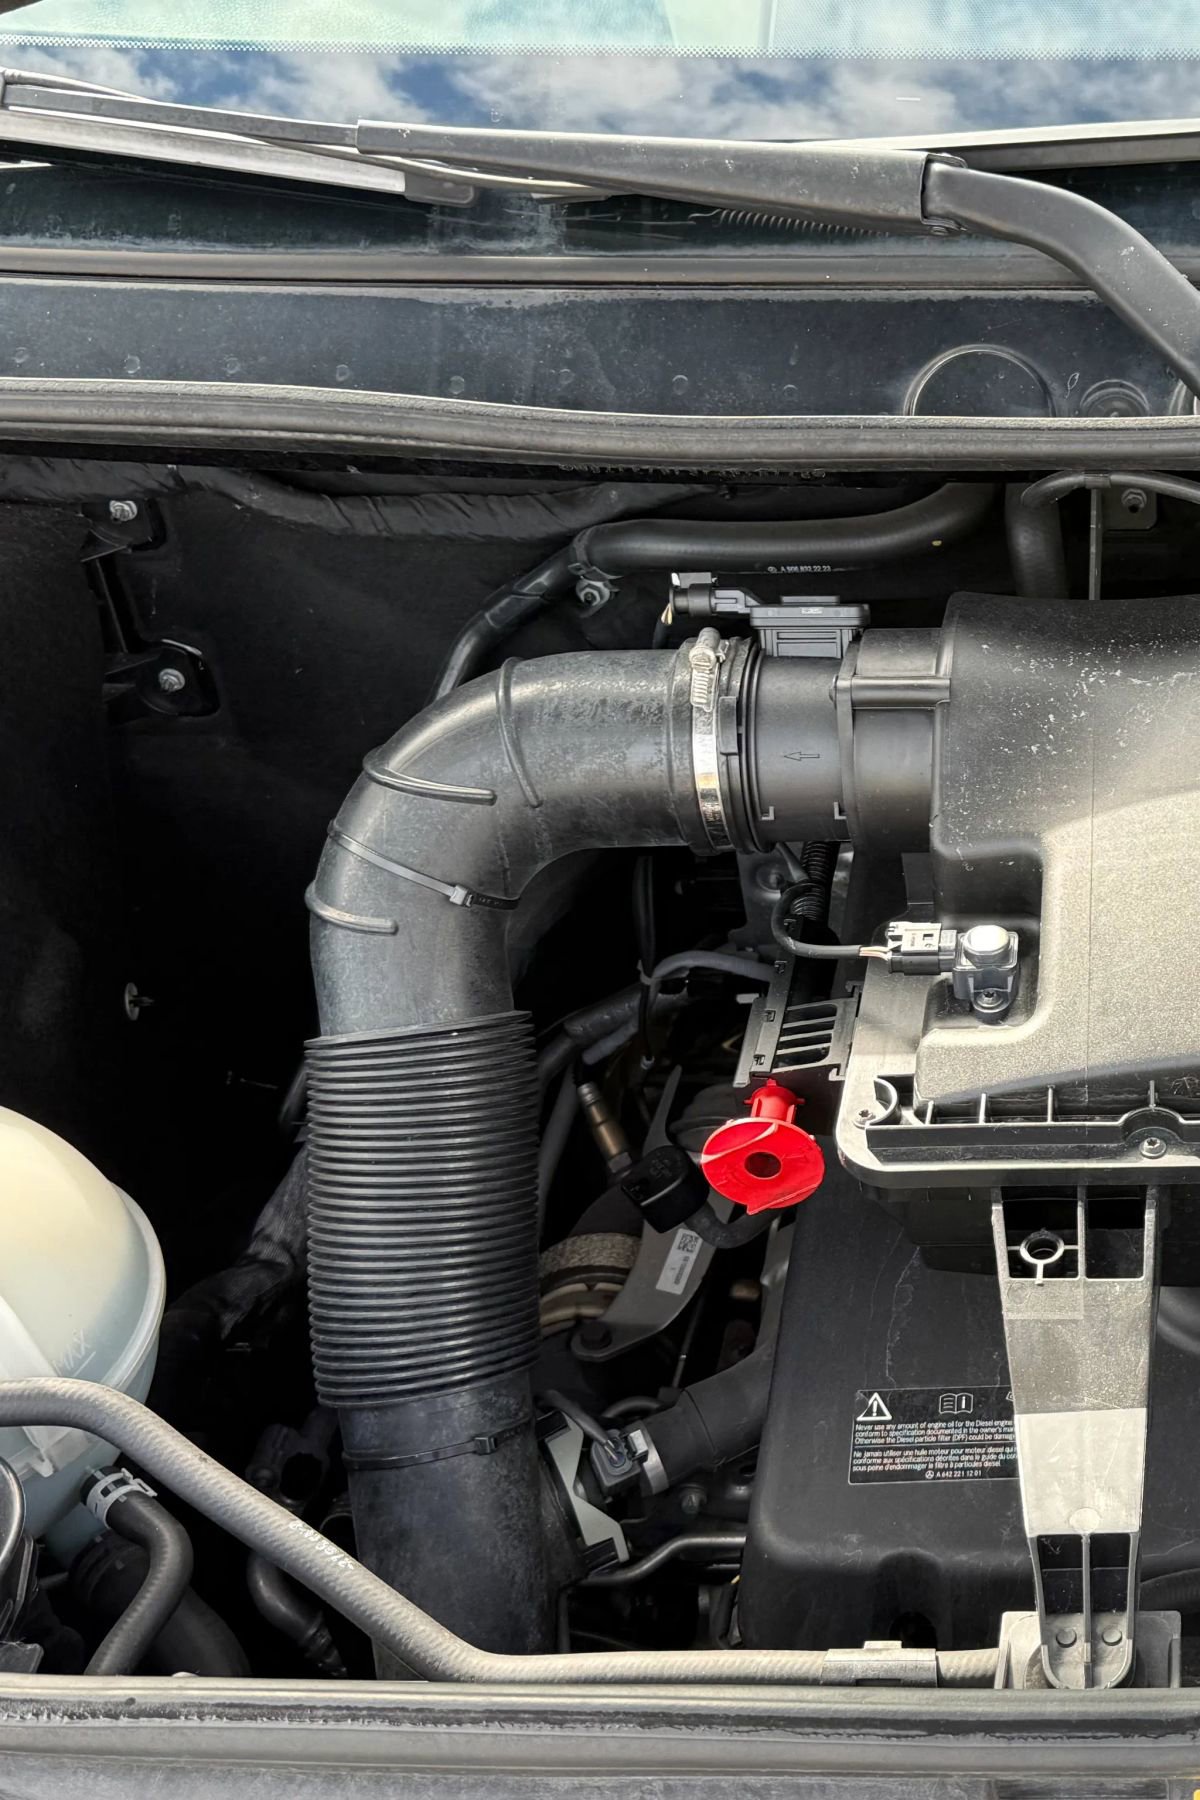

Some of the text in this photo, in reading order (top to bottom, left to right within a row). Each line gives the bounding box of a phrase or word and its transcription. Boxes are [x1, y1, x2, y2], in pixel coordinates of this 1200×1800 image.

[927, 1421, 946, 1429] engine
[889, 1429, 925, 1437] specification
[926, 1427, 962, 1435] documented
[952, 1434, 968, 1442] (DPF)
[883, 1449, 902, 1457] utiliser
[914, 1448, 927, 1456] huile
[950, 1447, 964, 1456] pour
[1005, 1446, 1013, 1454] qui
[853, 1457, 882, 1465] conforme
[981, 1453, 997, 1462] guide
[867, 1464, 884, 1472] peine
[884, 1462, 927, 1470] d'endommager
[954, 1460, 982, 1468] particules
